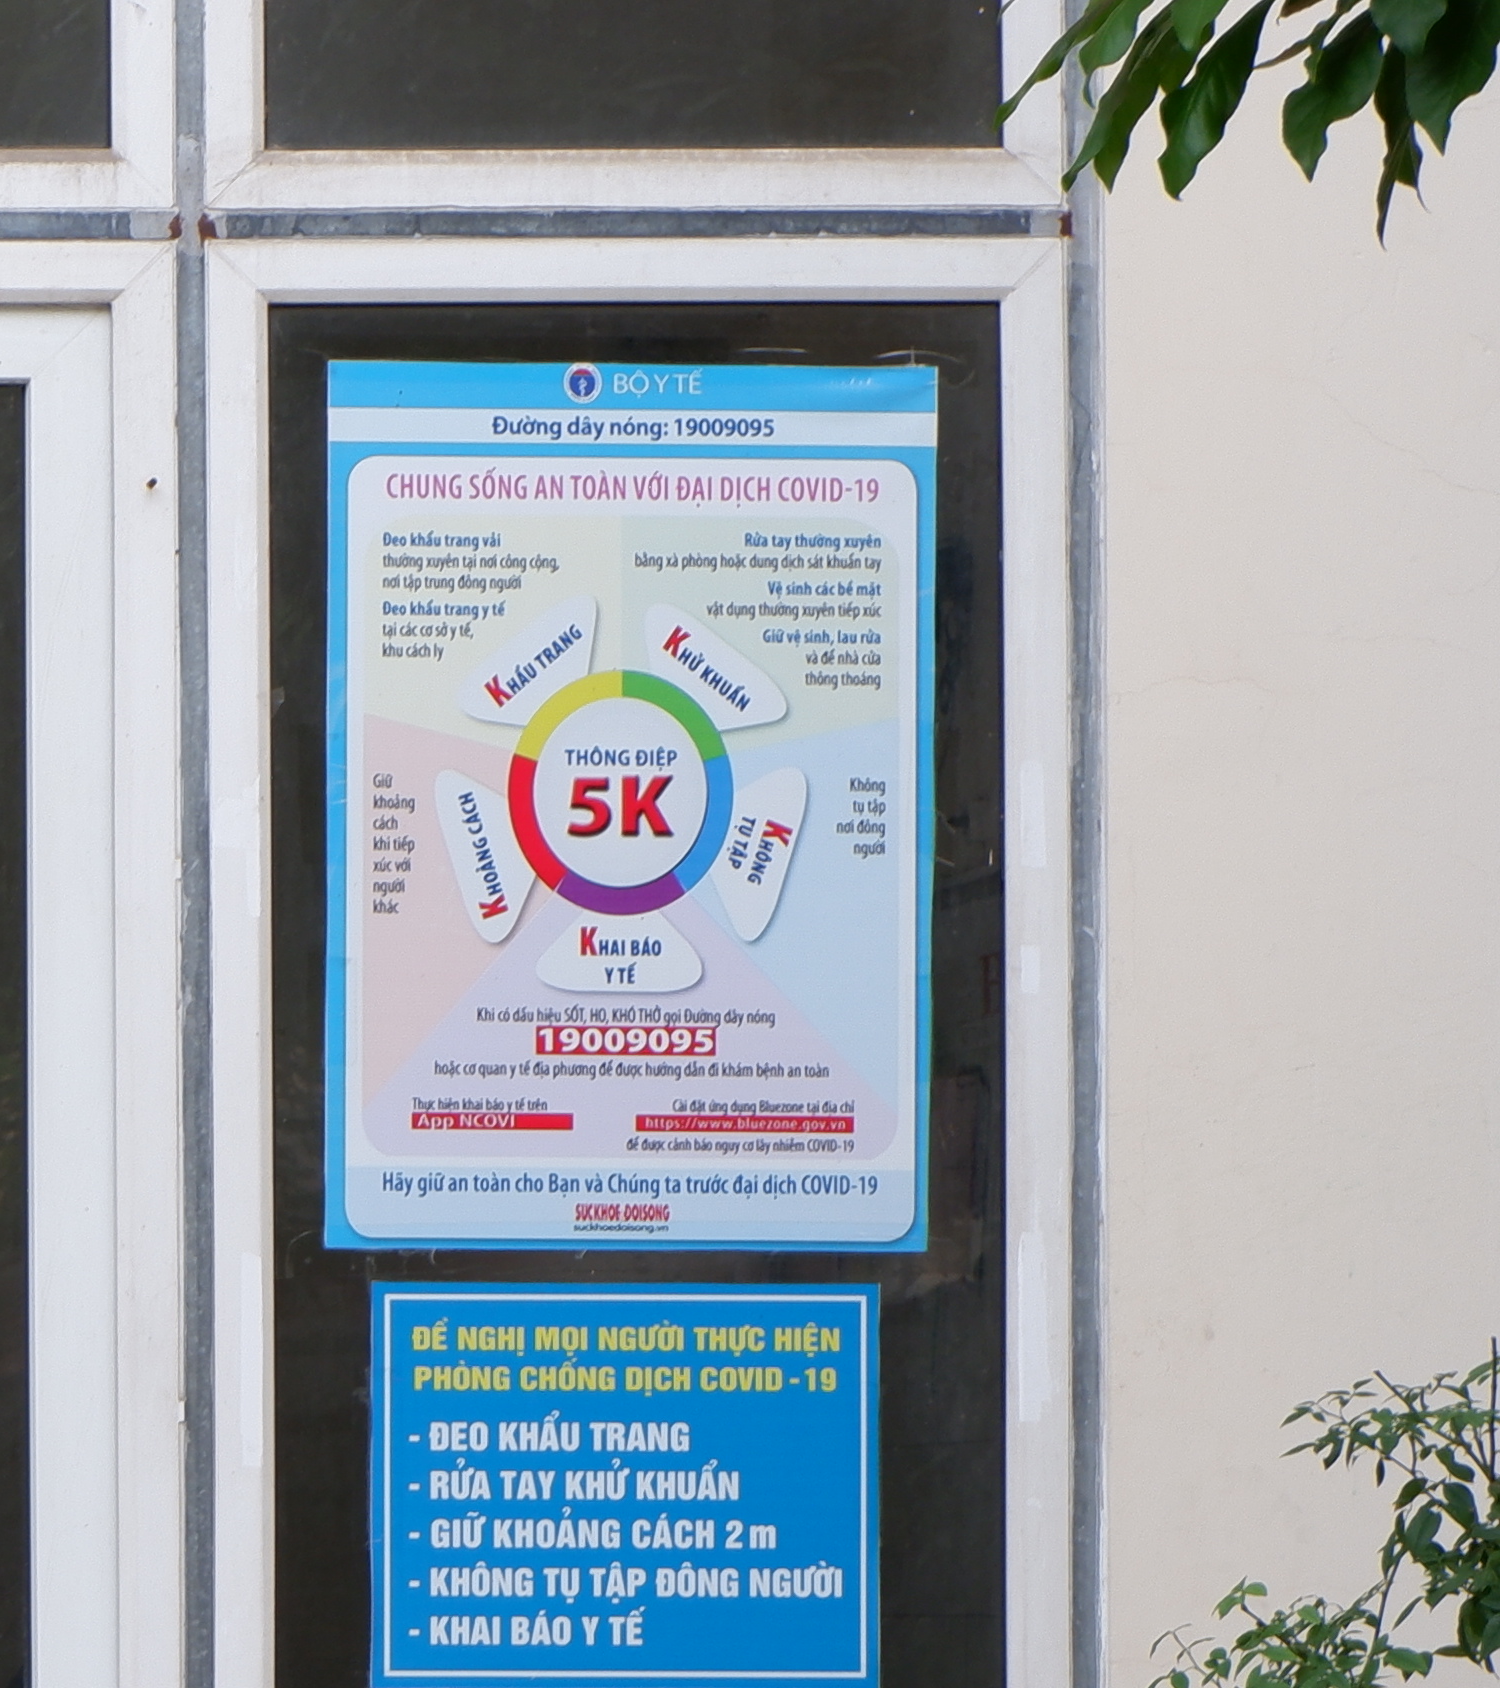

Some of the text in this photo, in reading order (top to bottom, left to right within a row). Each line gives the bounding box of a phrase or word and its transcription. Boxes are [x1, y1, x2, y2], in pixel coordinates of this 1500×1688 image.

[613, 368, 705, 399] BỘ Y TẾ
[492, 416, 774, 442] Đường dây nóng: 19009095
[386, 467, 879, 507] CHUNG SỐNG AN TOÀN VỚI ĐẠI DỊCH COVID-19
[565, 746, 677, 772] THÔNG ĐIỆP
[568, 775, 674, 837] 5K
[537, 1026, 716, 1055] 19009095
[412, 1317, 840, 1358] ĐỂ NGHỊ MỌI NGƯỜI THỰC HIỆN
[413, 1360, 510, 1391] PHÒNG
[520, 1357, 616, 1391] CHỐNG
[625, 1367, 691, 1397] DỊCH
[700, 1367, 783, 1391] COVID
[804, 1367, 838, 1392] 19
[429, 1410, 690, 1451] ĐEO KHẨU TRANG
[429, 1560, 843, 1604] KHÔNG TỤ TẬP ĐÔNG NGƯỜI
